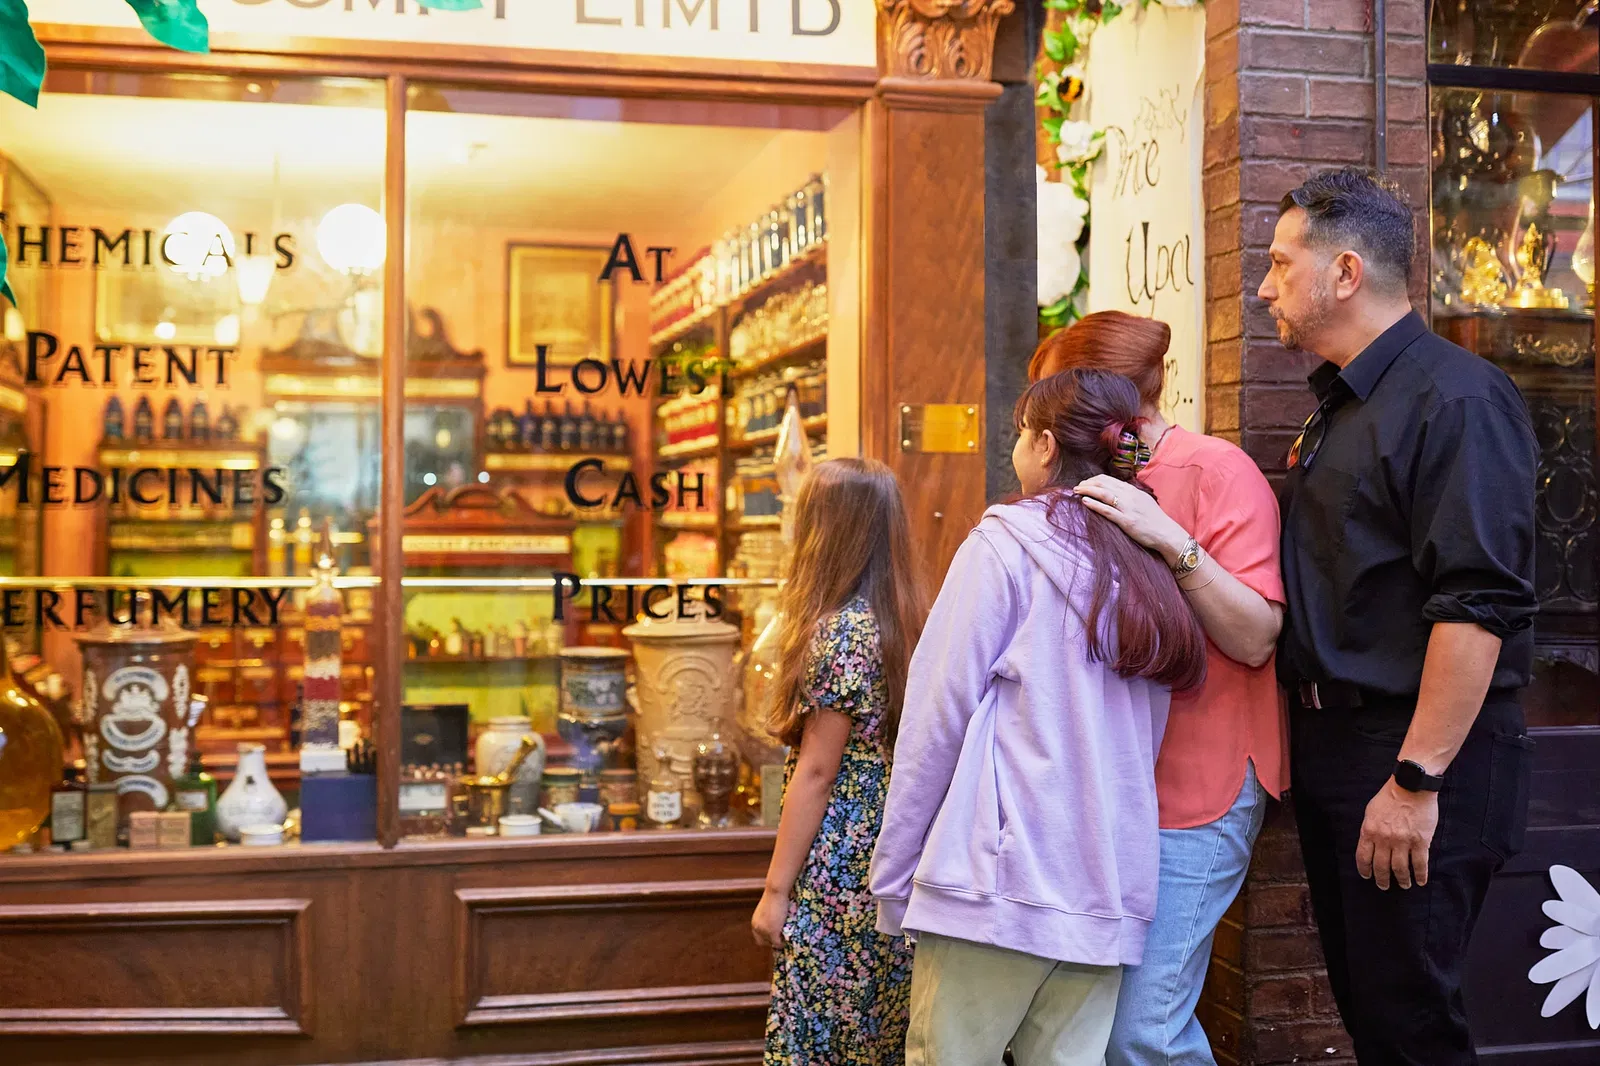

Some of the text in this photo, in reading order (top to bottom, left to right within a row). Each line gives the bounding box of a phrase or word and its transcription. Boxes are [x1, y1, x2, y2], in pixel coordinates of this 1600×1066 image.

[0, 210, 296, 269] HEMICALS
[25, 331, 236, 385] PATENT
[535, 344, 737, 395] LOWEST
[565, 458, 705, 508] CASH
[552, 572, 722, 622] PRICES
